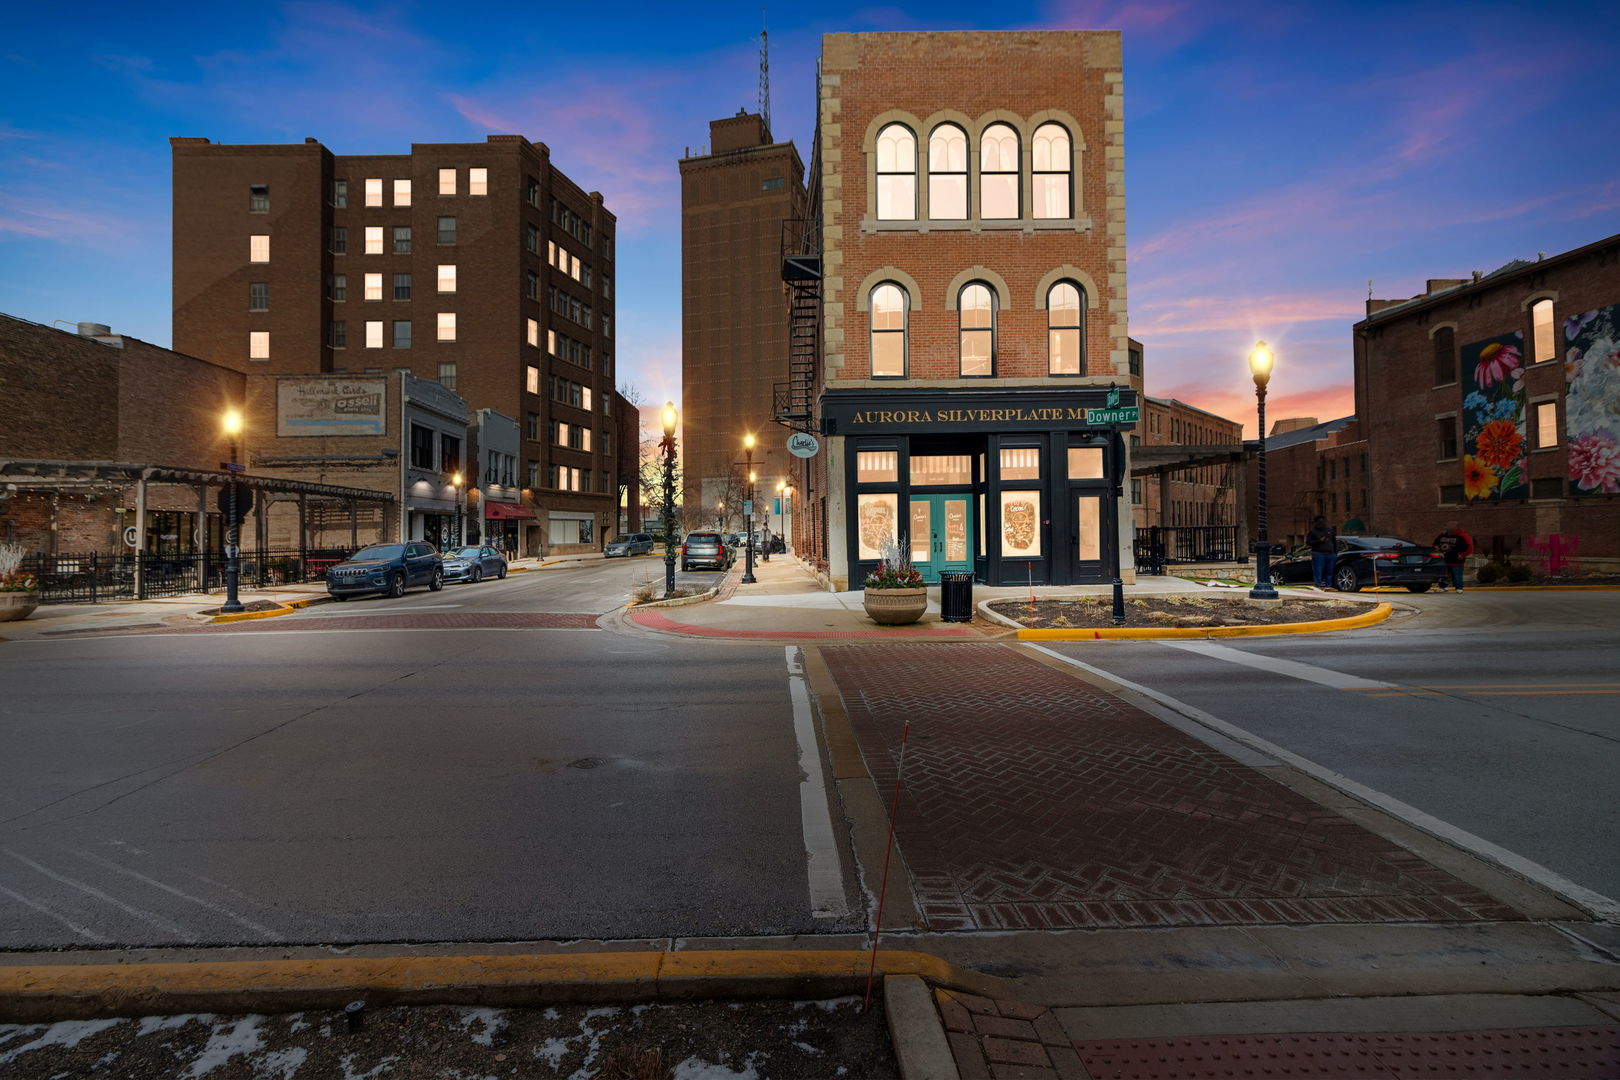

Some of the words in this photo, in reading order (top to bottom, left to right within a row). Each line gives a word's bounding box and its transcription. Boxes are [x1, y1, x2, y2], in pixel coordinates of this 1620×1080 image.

[852, 410, 932, 423] AURORA
[937, 408, 1063, 421] SILVERPLATE
[1088, 411, 1131, 423] Downer
[791, 435, 815, 448] Charlie's
